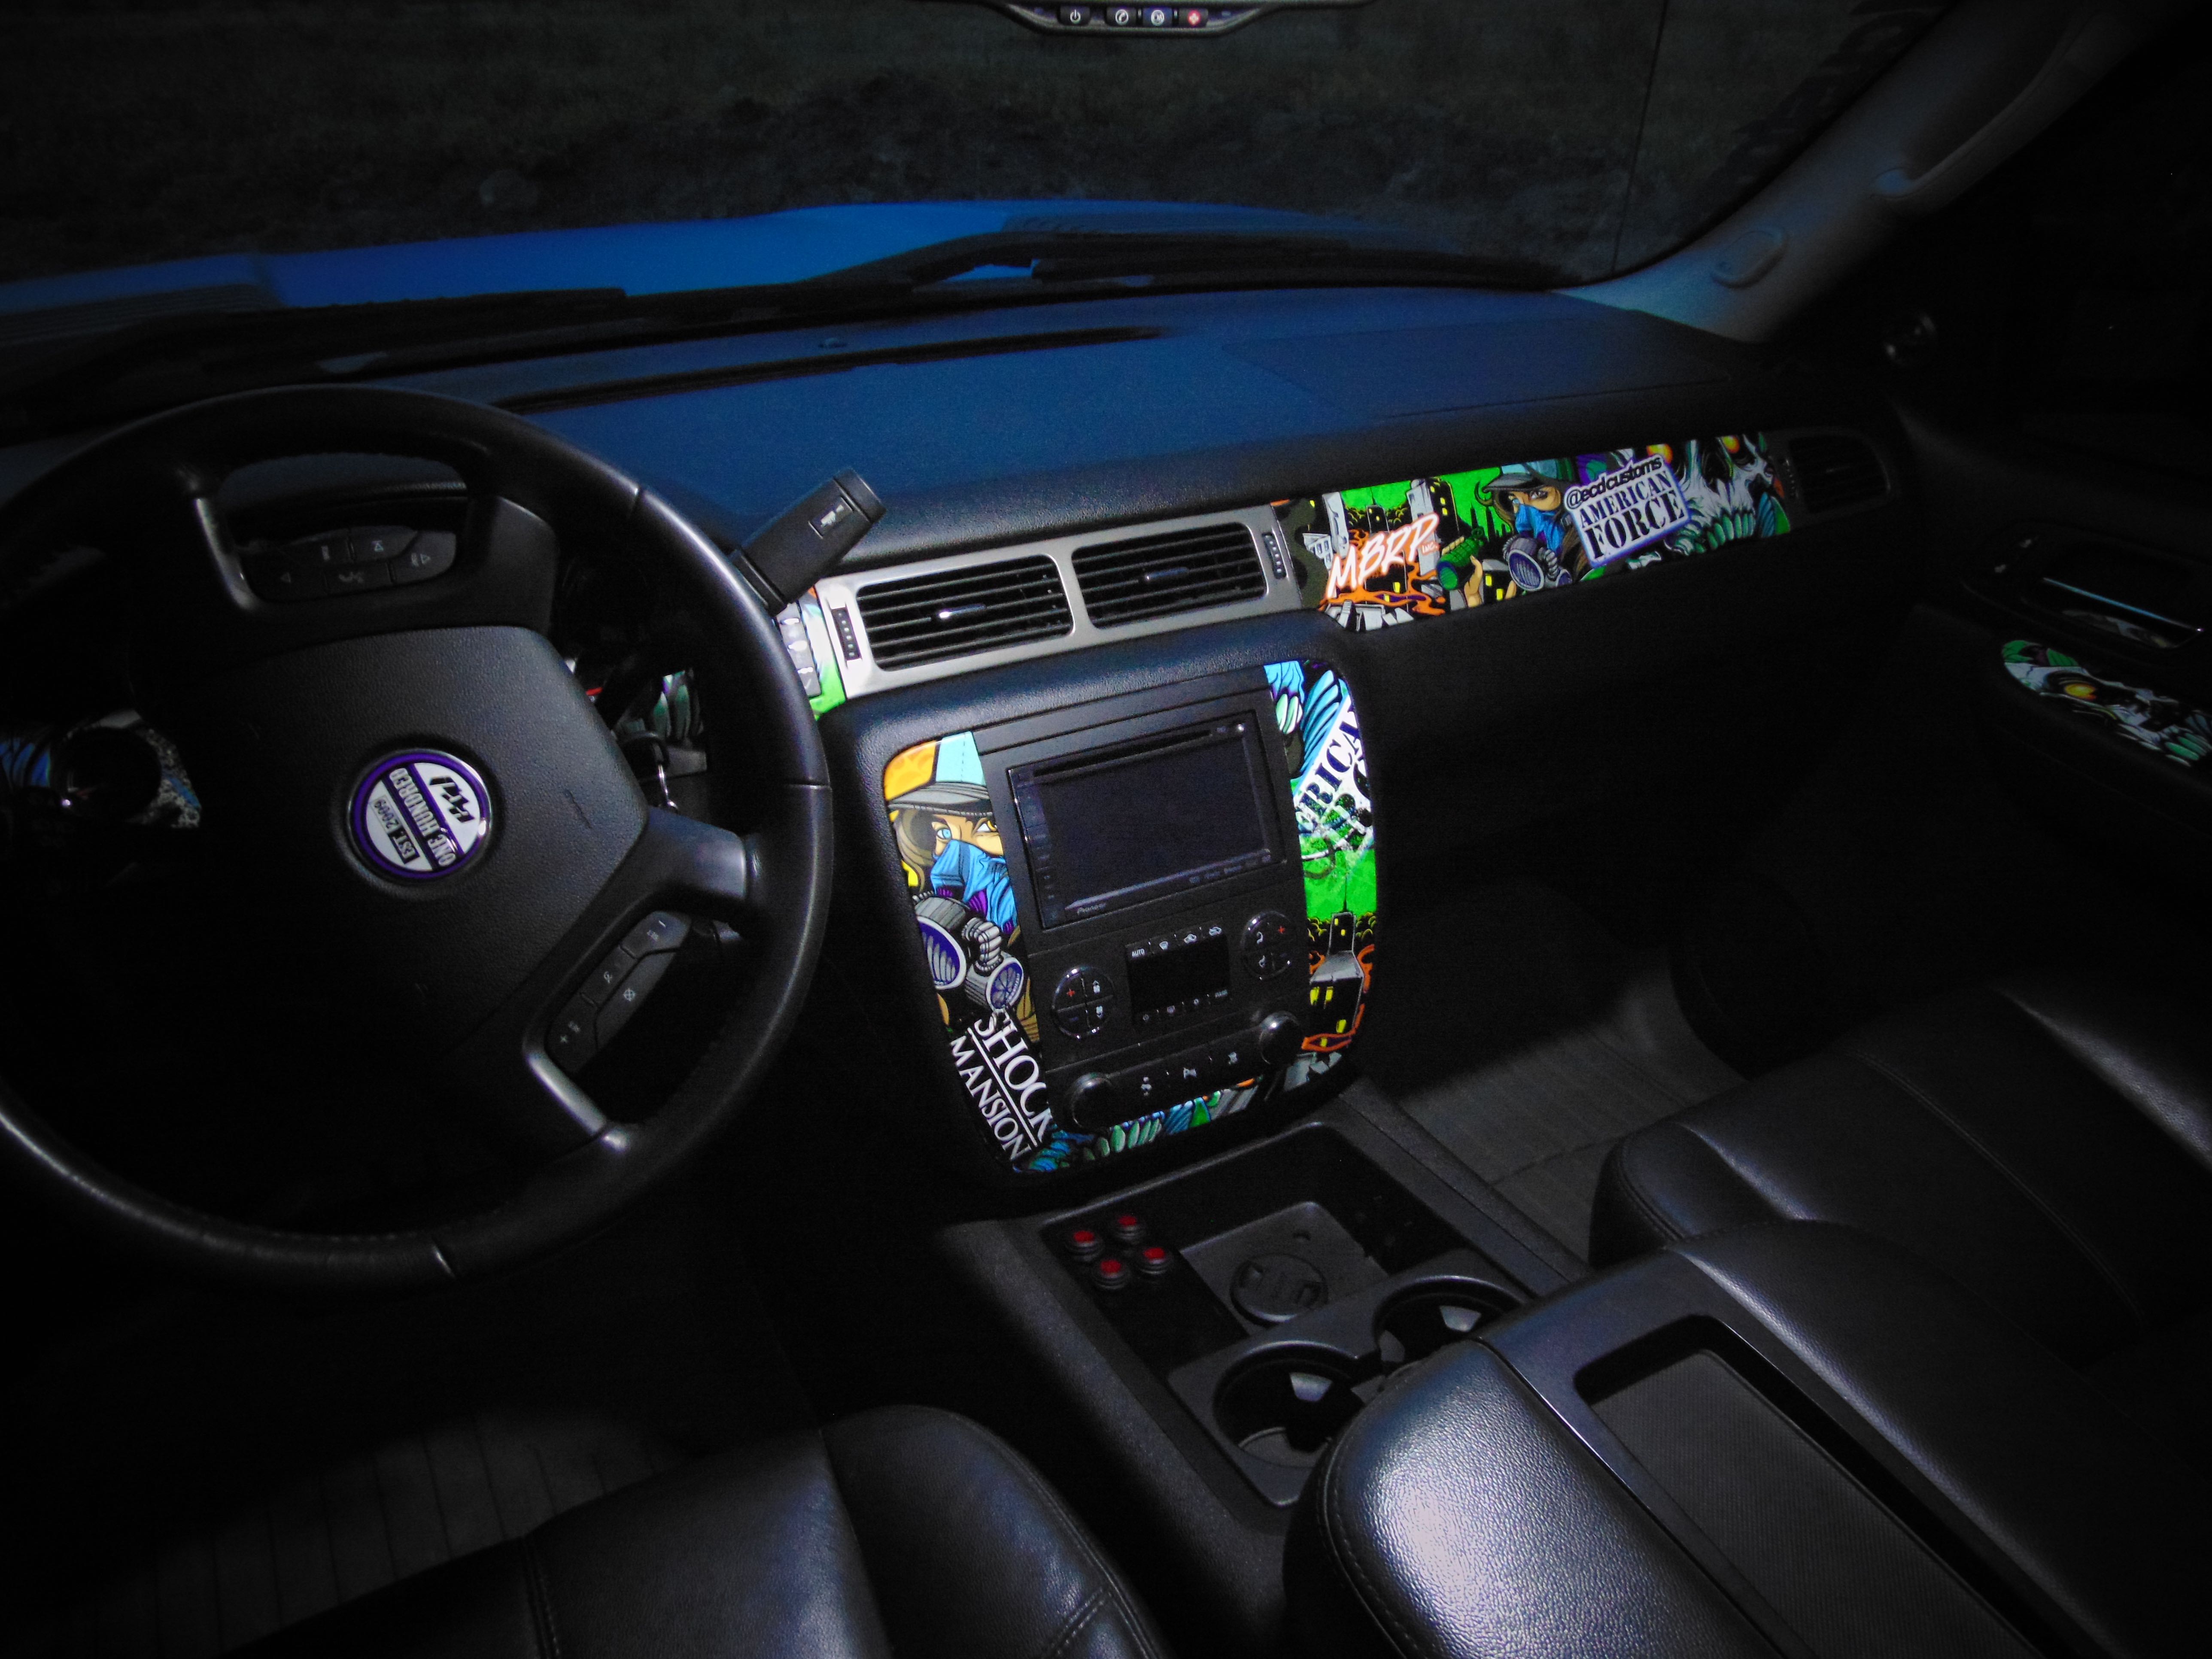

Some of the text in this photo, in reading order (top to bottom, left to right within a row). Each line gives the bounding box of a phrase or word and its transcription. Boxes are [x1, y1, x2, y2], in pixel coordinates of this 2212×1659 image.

[1580, 471, 1672, 529] AMERICAN
[1585, 490, 1684, 559] FORCE
[1326, 513, 1438, 599] MBRP
[389, 768, 441, 838] HUNDRED
[427, 834, 456, 866] ONE
[1131, 948, 1145, 957] AUTO
[949, 1035, 1032, 1160] MANSION
[973, 1012, 1053, 1143] SHOCK
